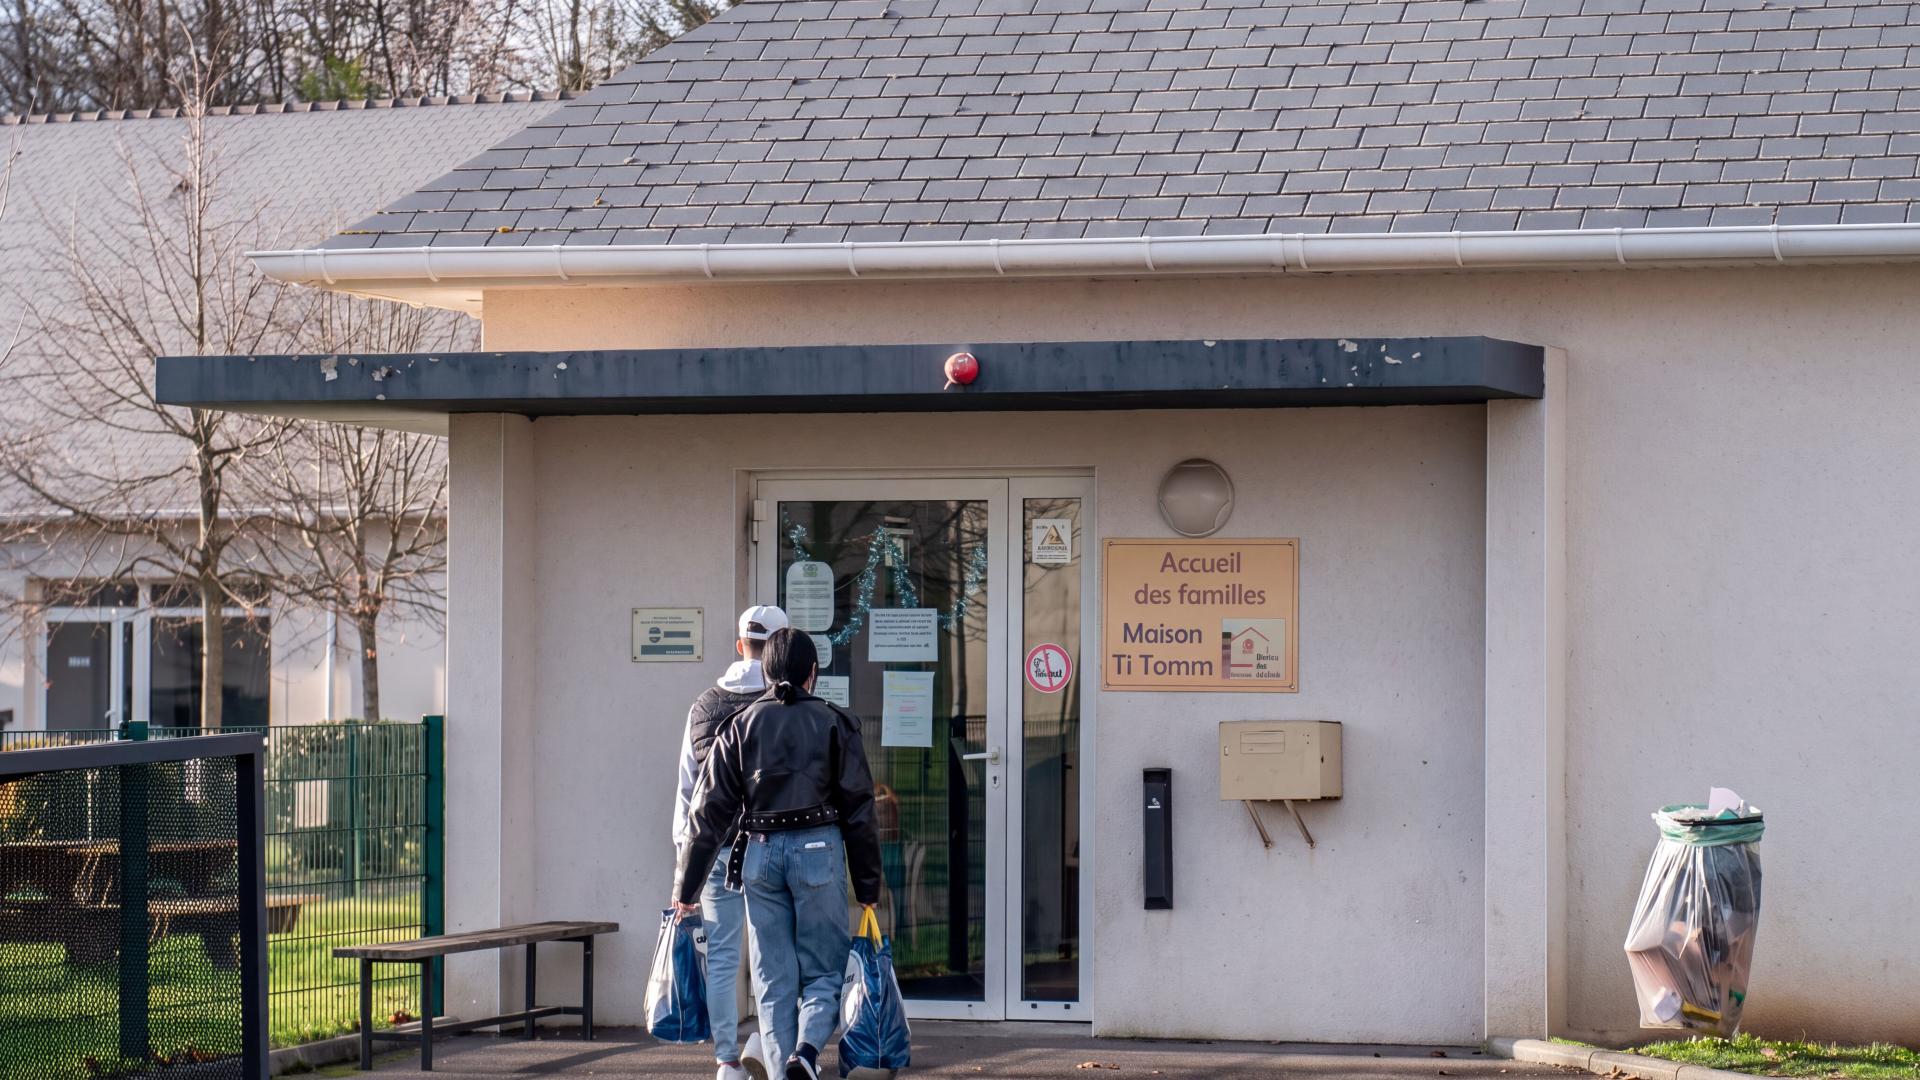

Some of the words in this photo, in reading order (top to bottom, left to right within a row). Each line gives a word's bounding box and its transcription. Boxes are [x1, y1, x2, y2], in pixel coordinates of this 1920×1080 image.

[1160, 551, 1241, 573] Accueil
[1134, 583, 1172, 605] des
[1178, 583, 1266, 605] familles
[1123, 622, 1203, 644] Maison
[1112, 654, 1132, 675] Ti
[1139, 654, 1213, 676] Tomm
